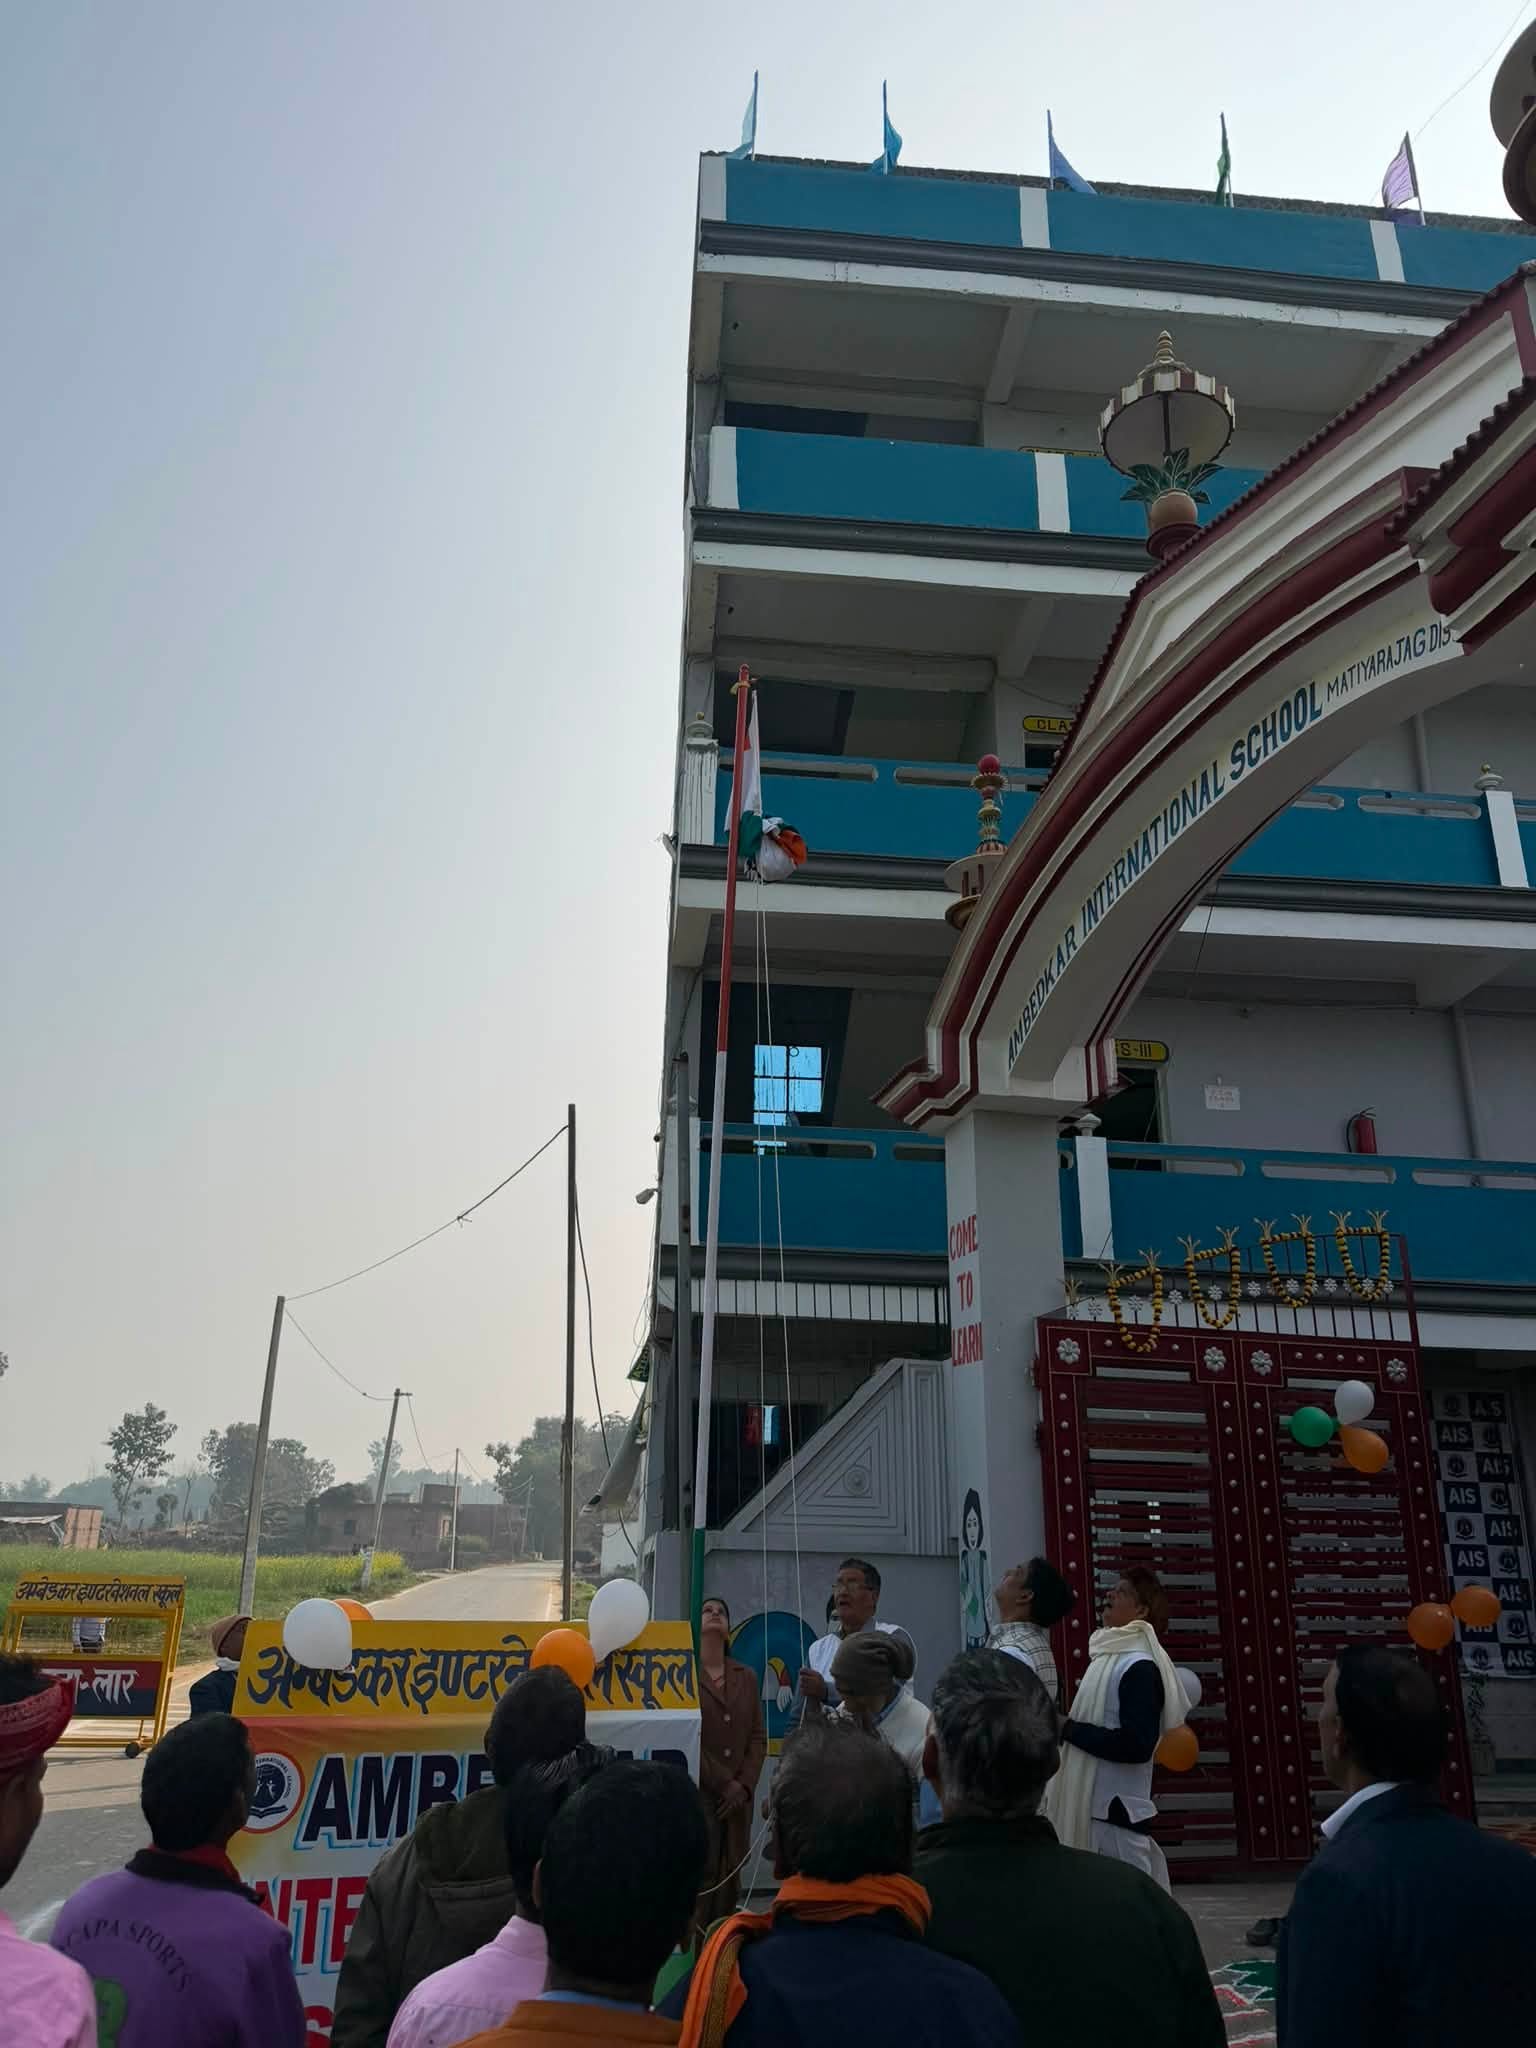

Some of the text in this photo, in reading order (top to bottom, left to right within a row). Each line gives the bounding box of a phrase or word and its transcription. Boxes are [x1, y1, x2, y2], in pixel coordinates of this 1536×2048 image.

[1037, 718, 1070, 732] CLA
[1008, 925, 1077, 1069] AMBEDKAR
[1081, 760, 1225, 934] INTERNATIONAL
[1230, 682, 1323, 780] SCHOOL
[1429, 621, 1459, 654] DIS
[949, 1214, 979, 1261] COME
[956, 1271, 974, 1312] TO
[951, 1322, 984, 1367] LEARN
[1440, 1425, 1471, 1443] AIS
[1483, 1456, 1512, 1475] AIS
[1448, 1486, 1477, 1505] AIS
[1457, 1550, 1487, 1569] AIS
[1506, 1648, 1536, 1670] AIS
[128, 1919, 192, 1993] SPORTS
